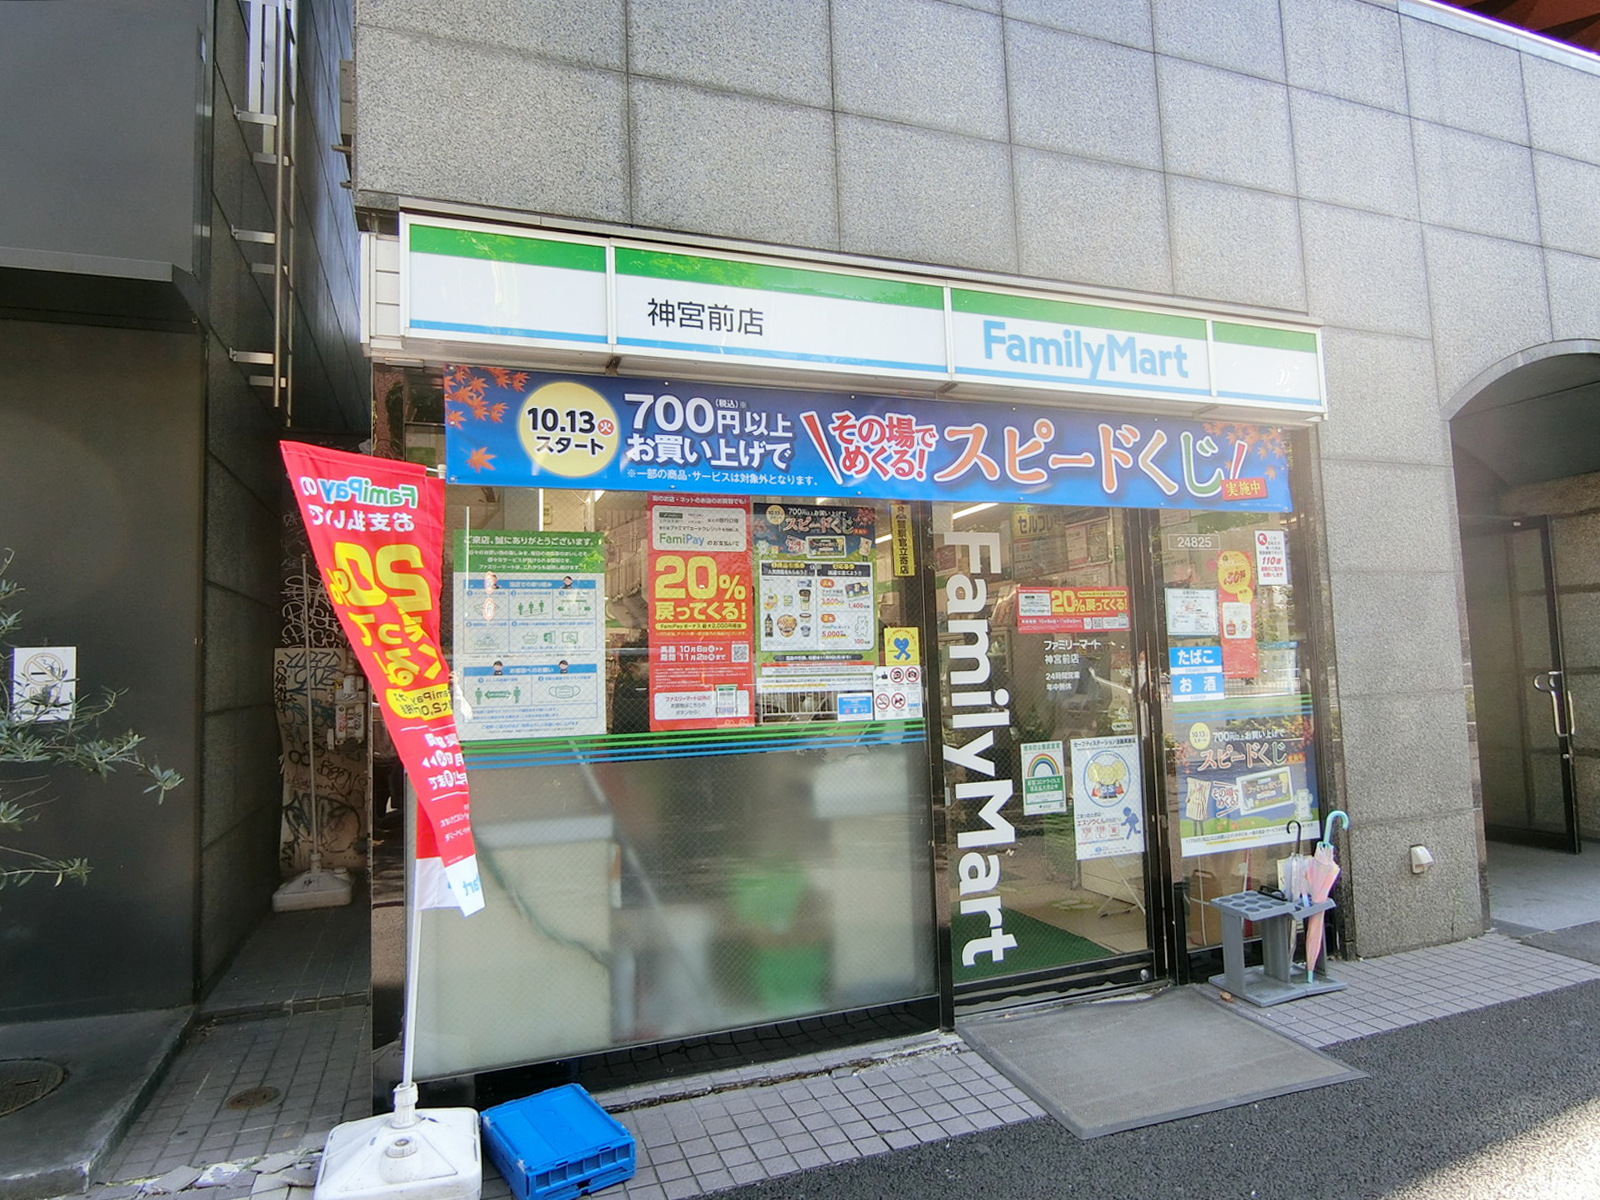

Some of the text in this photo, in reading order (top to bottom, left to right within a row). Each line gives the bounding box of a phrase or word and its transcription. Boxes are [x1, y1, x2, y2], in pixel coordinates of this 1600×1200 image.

[647, 297, 764, 337] 神宮前店
[983, 320, 1188, 381] FamilyMart
[831, 413, 938, 449] その場で
[535, 434, 605, 456] スタート
[626, 436, 792, 470] お買い上げで
[841, 448, 928, 481] めくる!
[1225, 480, 1261, 497] 実施中
[659, 532, 705, 546] FamiPay
[1177, 536, 1212, 548] 24825
[655, 555, 746, 600] 20%
[655, 601, 746, 621] 戻ってくる!
[1051, 590, 1086, 612] 20%
[1043, 639, 1101, 650] ファミリーマート
[1045, 653, 1079, 664] 神宮前店
[1178, 649, 1214, 665] たばこ
[1045, 671, 1080, 680] 24時間営業
[1046, 683, 1072, 691] 年中無休
[943, 532, 1018, 966] FamilyMart
[1197, 742, 1288, 771] スピードくじ
